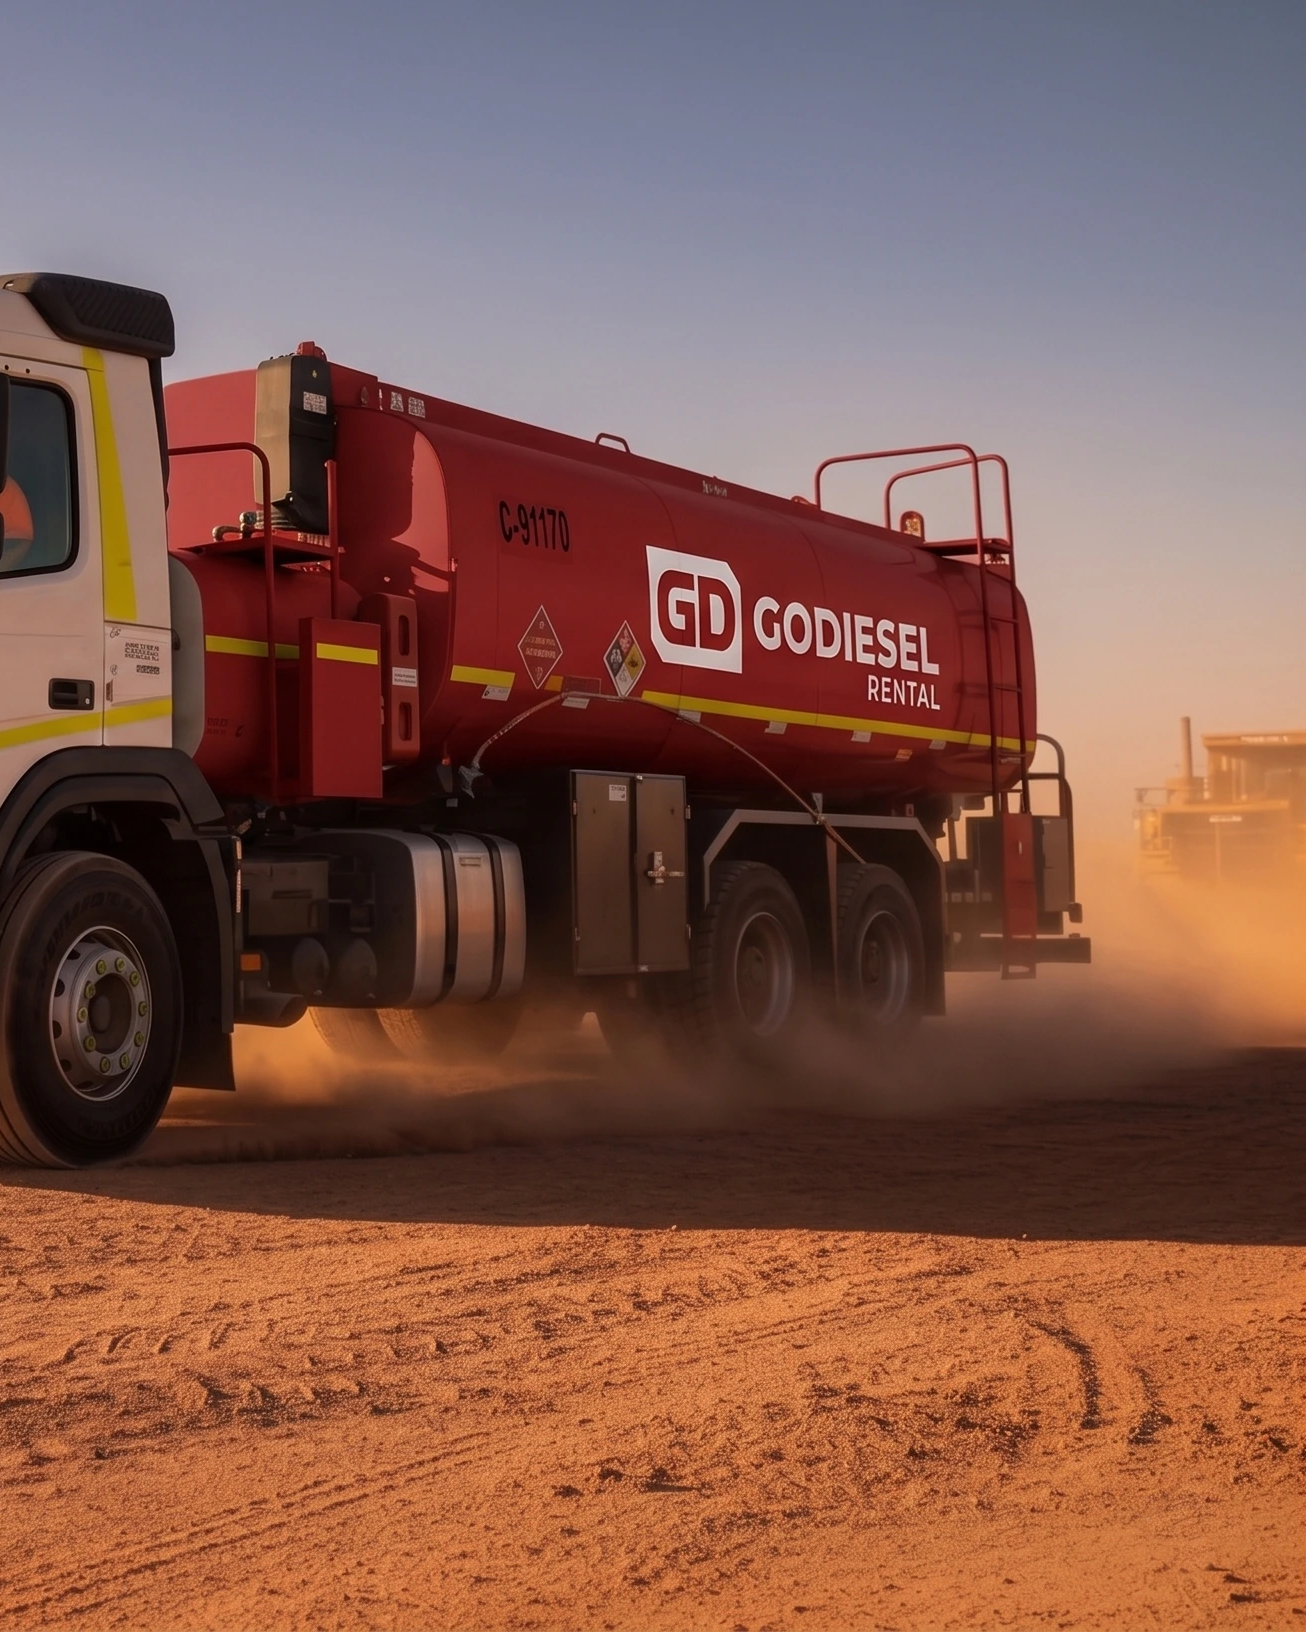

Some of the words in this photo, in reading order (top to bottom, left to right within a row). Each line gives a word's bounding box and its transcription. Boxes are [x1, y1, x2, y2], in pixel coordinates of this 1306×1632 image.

[499, 500, 570, 553] C-91170
[656, 568, 736, 652] GD
[753, 596, 940, 676] GODIESEL
[867, 674, 941, 711] RENTAL
